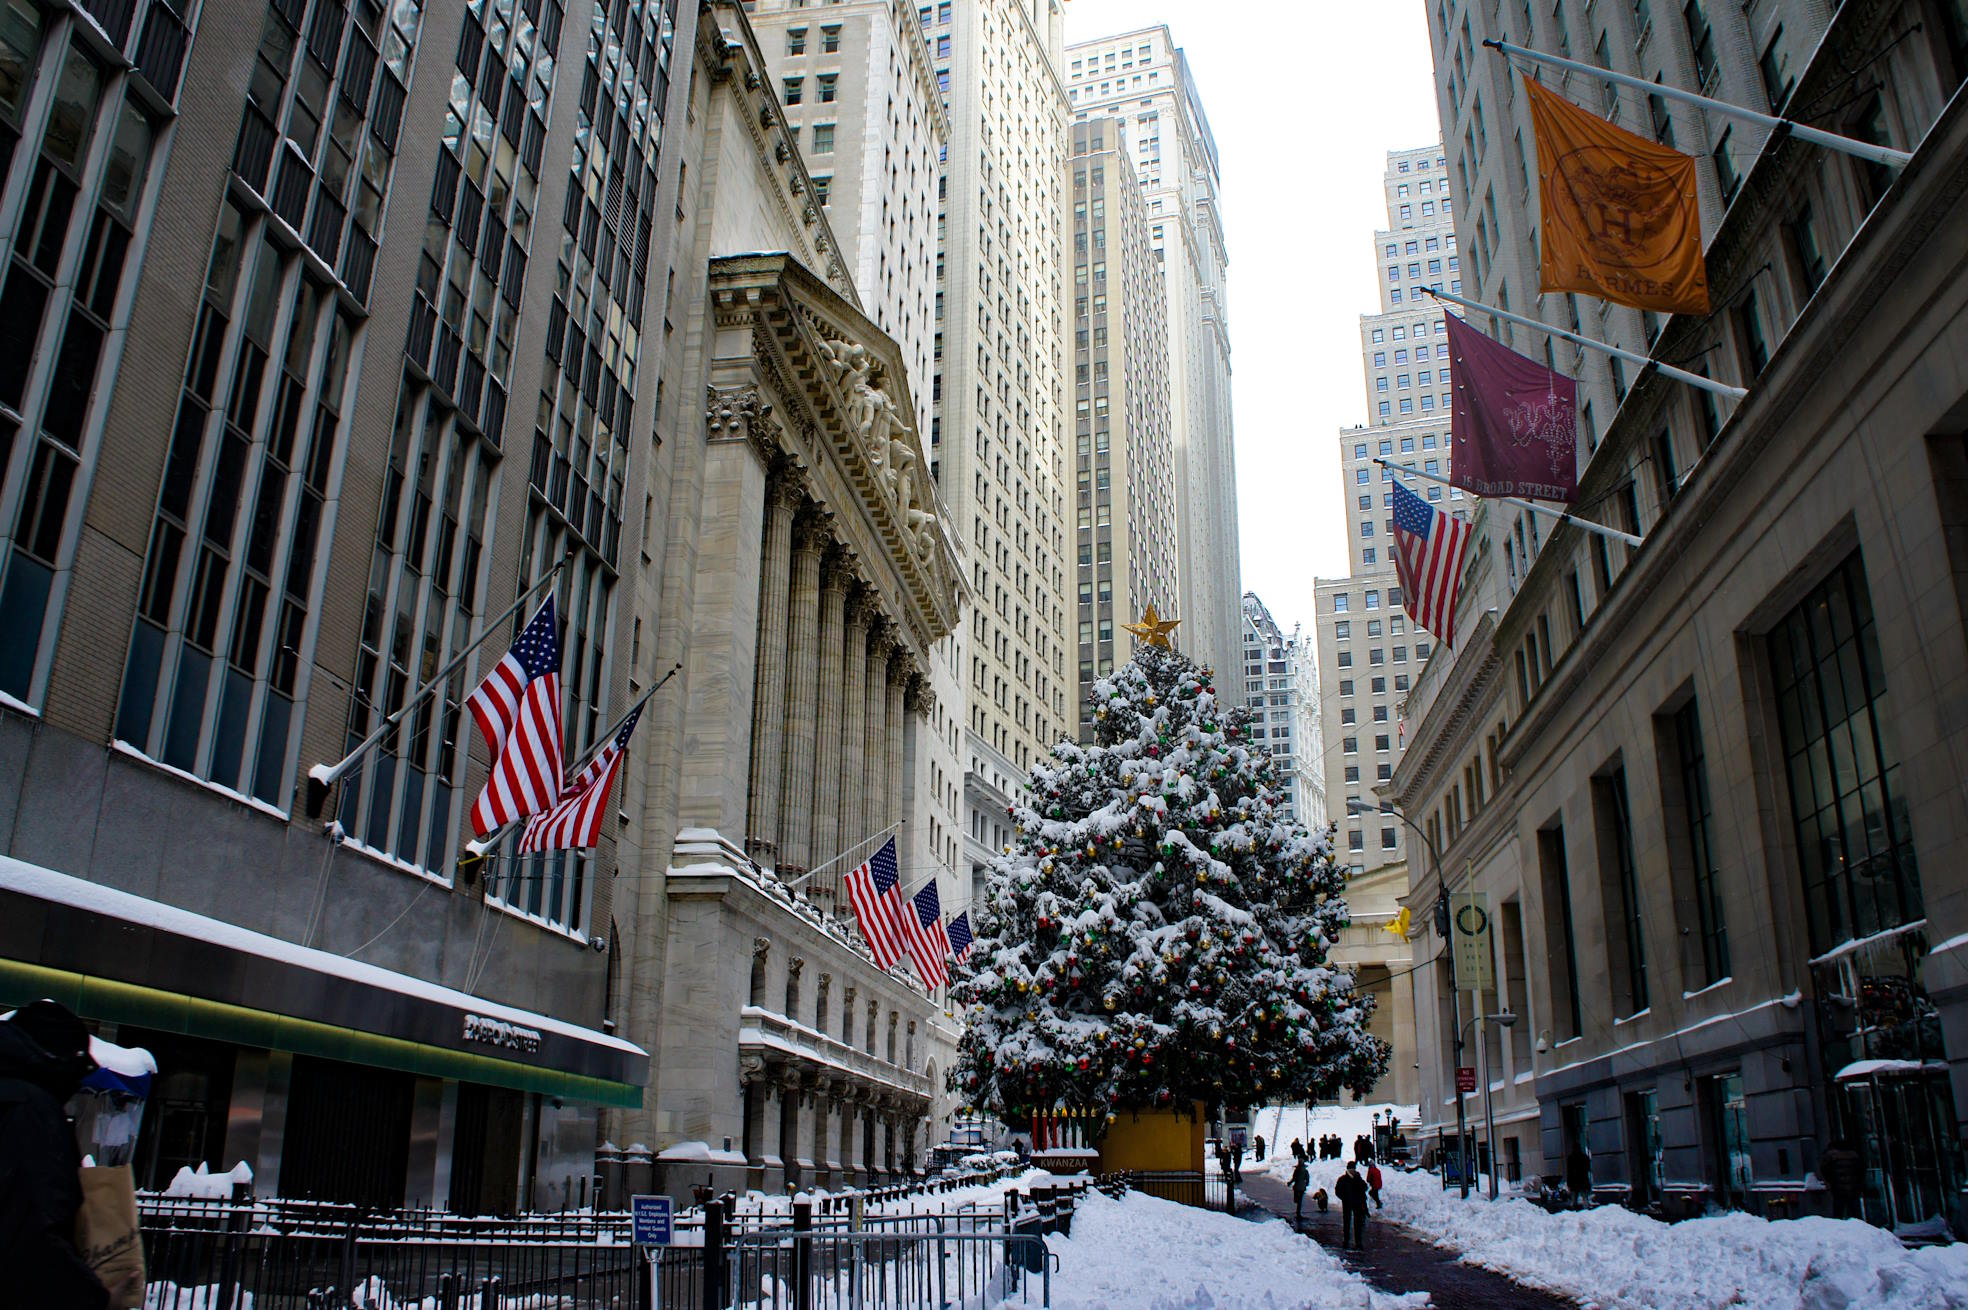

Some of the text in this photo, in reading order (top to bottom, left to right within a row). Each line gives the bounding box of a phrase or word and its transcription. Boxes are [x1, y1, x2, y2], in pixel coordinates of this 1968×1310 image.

[1575, 263, 1674, 297] HRMES
[1462, 474, 1568, 500] 15 BROAD STREET
[479, 1020, 513, 1048] BROAD
[1040, 1157, 1088, 1168] KWANZAA
